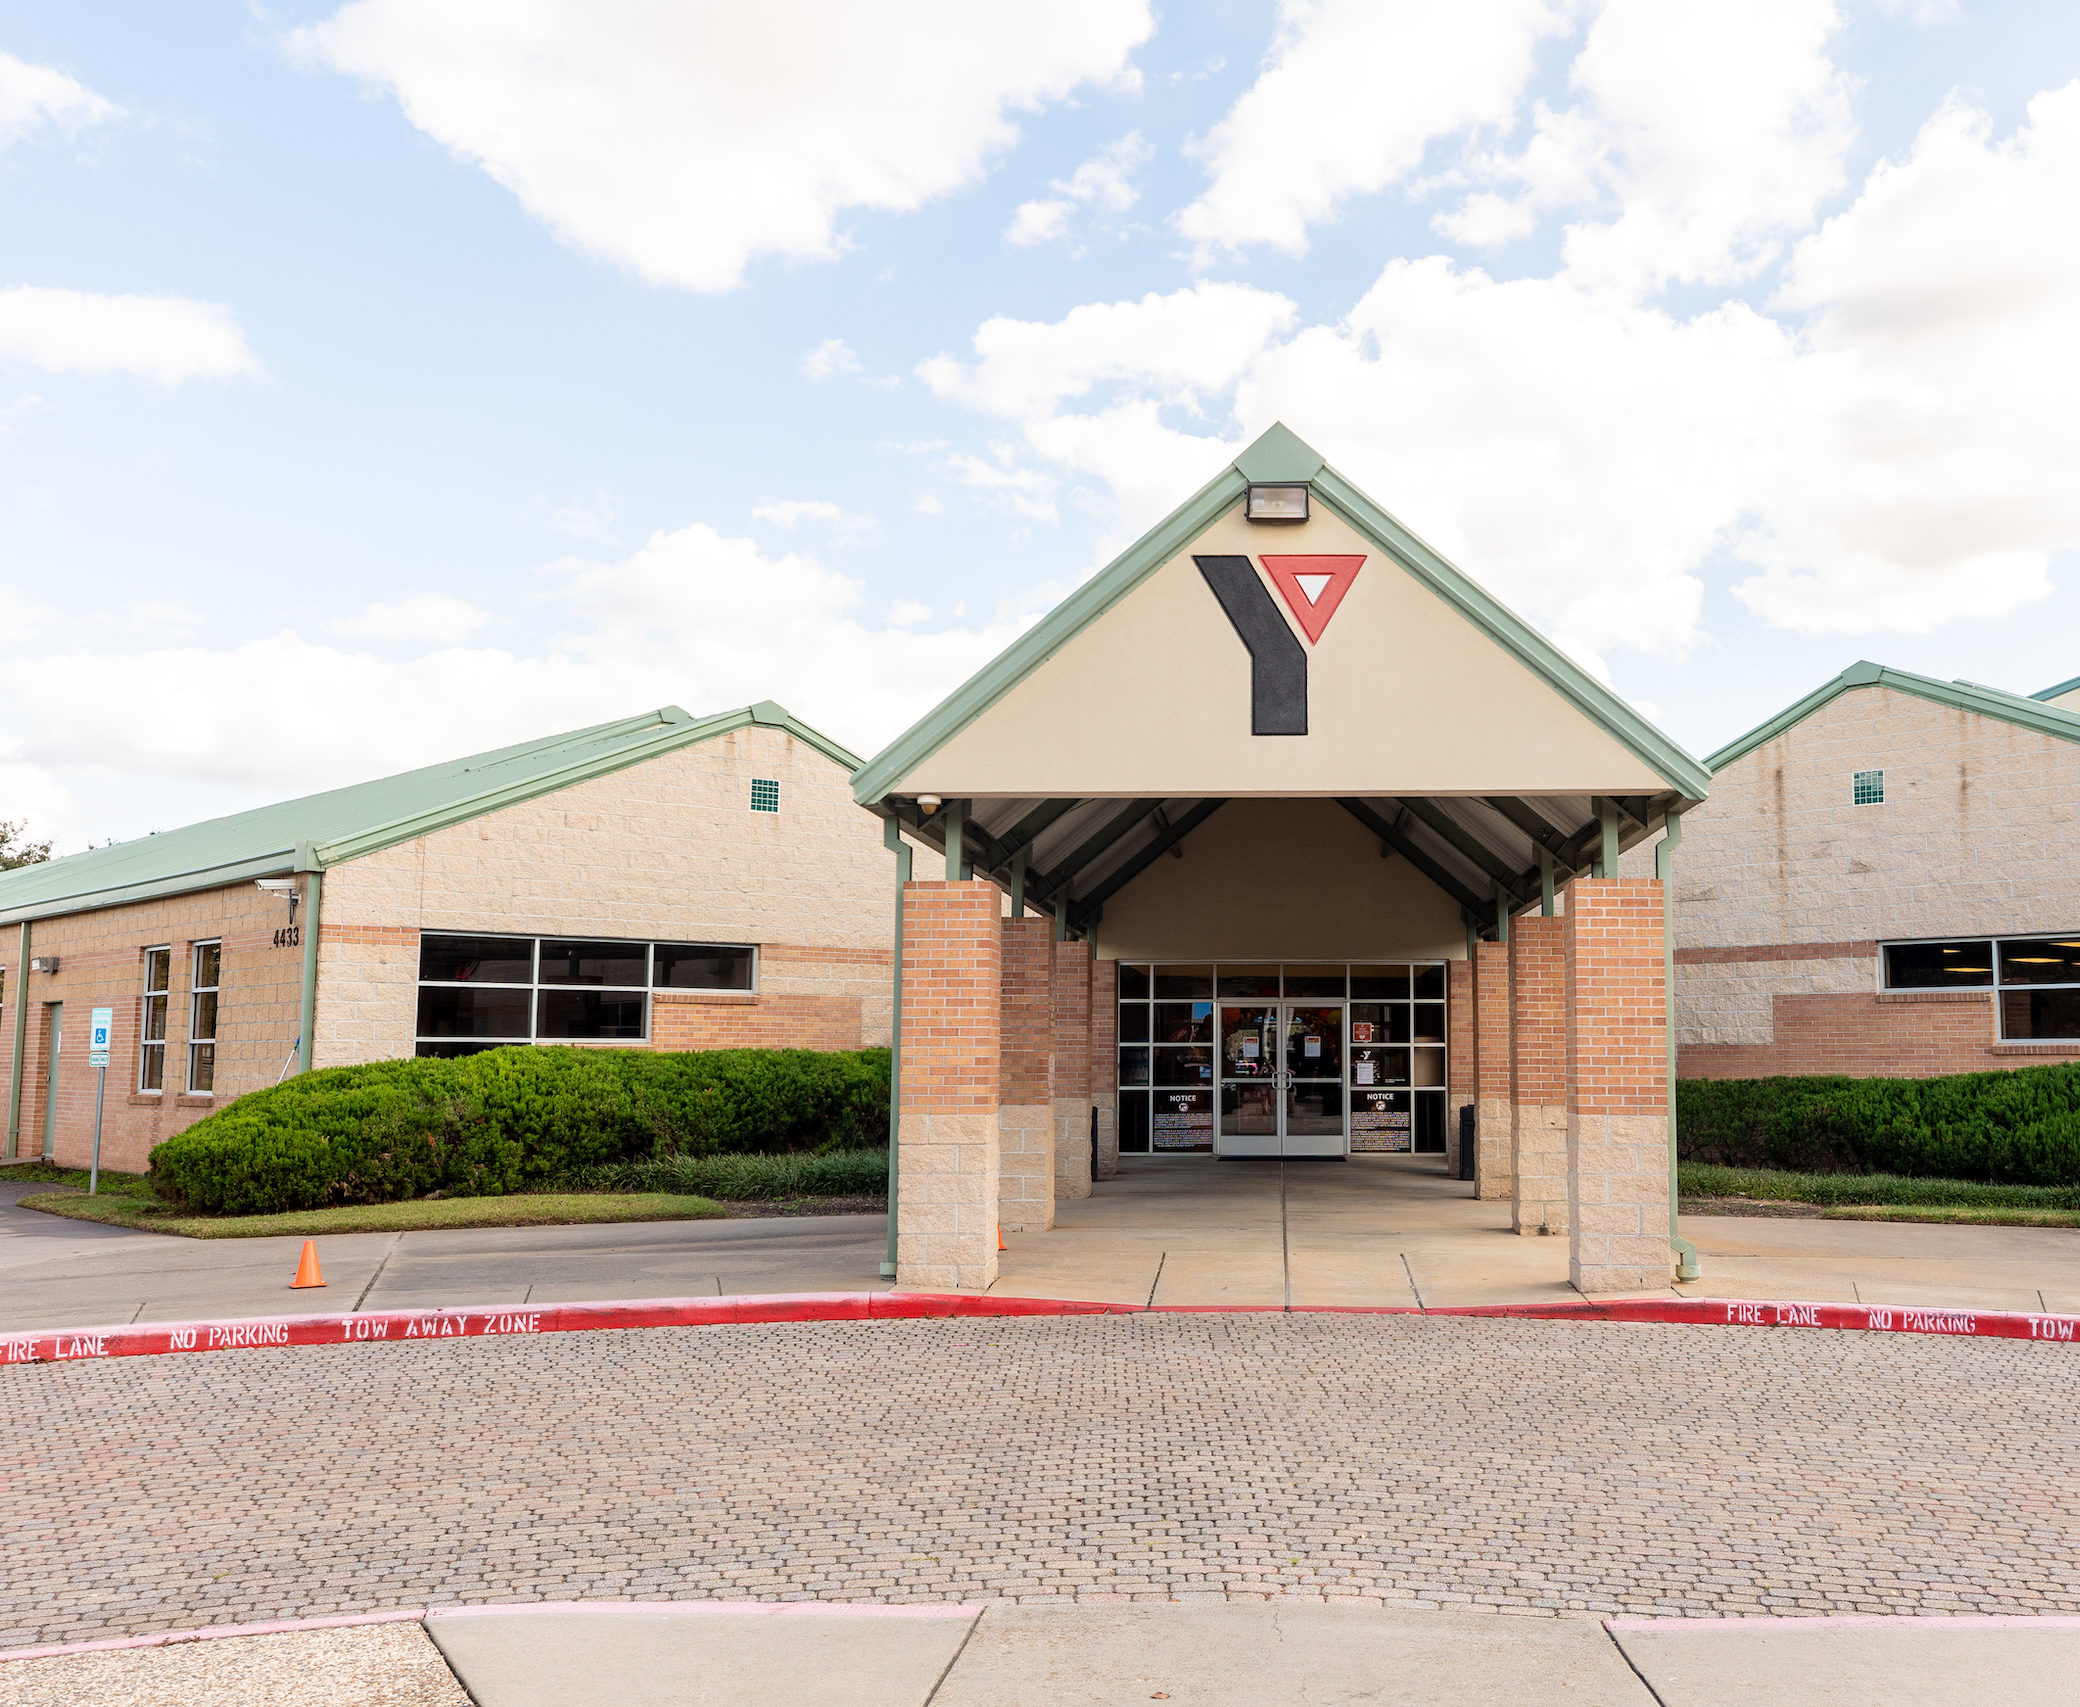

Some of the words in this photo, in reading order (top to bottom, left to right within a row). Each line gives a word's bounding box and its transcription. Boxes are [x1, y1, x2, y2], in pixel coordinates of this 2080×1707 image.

[273, 926, 299, 949] 4433
[1170, 1094, 1197, 1102] NOTICE
[1367, 1093, 1394, 1101] NOTICE
[341, 1319, 389, 1339] TOW
[405, 1315, 468, 1337] AWAY
[484, 1314, 541, 1334] ZONE
[1727, 1304, 1765, 1324] FIRE
[1776, 1305, 1822, 1326] LANE
[1868, 1308, 1893, 1329] NO
[1903, 1311, 1976, 1333] PARKING
[170, 1328, 197, 1350] NO
[208, 1323, 289, 1347] PARKING
[2028, 1318, 2075, 1340] TOW
[55, 1335, 110, 1358] LANE
